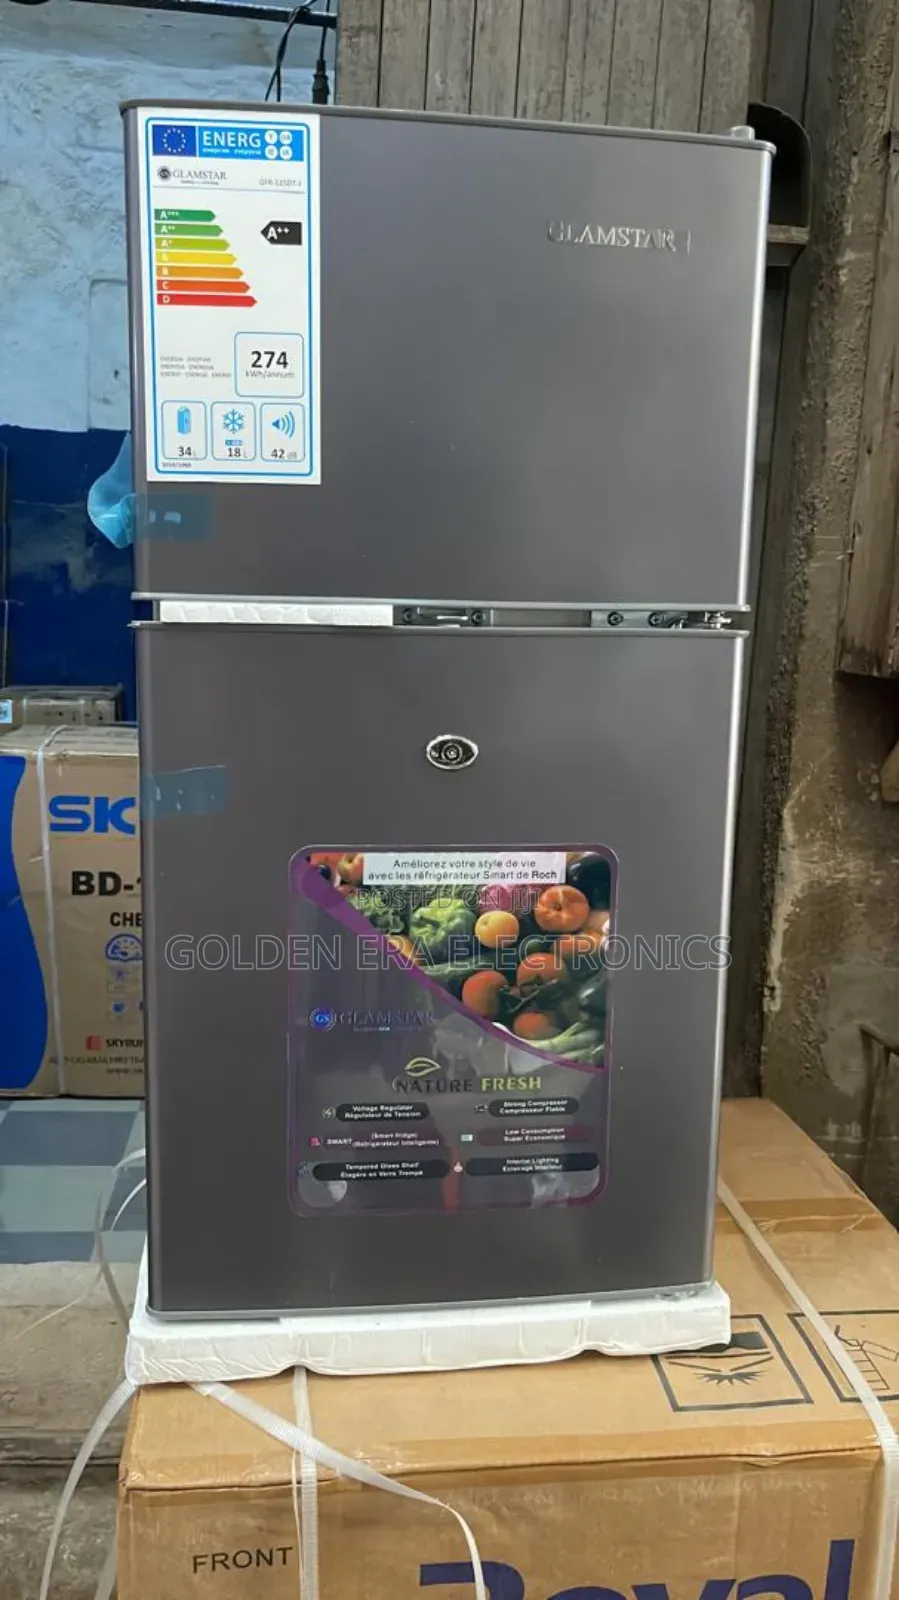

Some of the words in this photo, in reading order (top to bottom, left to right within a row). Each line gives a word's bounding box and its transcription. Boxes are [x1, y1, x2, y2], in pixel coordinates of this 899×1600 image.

[202, 130, 262, 148] ENERG
[172, 168, 227, 181] GLAMSTAR
[160, 210, 179, 220] A+++
[161, 225, 176, 234] A++
[267, 226, 290, 240] A++
[547, 220, 677, 253] GLAMSTAR
[162, 281, 169, 290] C
[162, 295, 170, 303] D
[251, 350, 289, 369] 274
[177, 446, 192, 457] 34
[227, 447, 242, 458] 18
[271, 449, 286, 460] 42
[393, 858, 447, 869] Améliorez
[448, 860, 477, 869] votre
[478, 859, 503, 870] style
[505, 859, 519, 868] de
[520, 860, 537, 868] vie
[368, 871, 394, 880] avec
[395, 871, 412, 880] les
[414, 870, 481, 882] réfrigérateur
[482, 870, 514, 880] Smart
[516, 870, 530, 880] de
[531, 870, 558, 880] Roch
[71, 870, 142, 896] BD-
[396, 1079, 473, 1094] NATURE
[481, 1076, 542, 1091] FRESH
[352, 1105, 379, 1113] Voltage
[380, 1104, 413, 1112] Regulator
[499, 1107, 545, 1115] Compresseur
[327, 1137, 352, 1145] SMART
[345, 1163, 379, 1171] Tempered
[192, 1546, 294, 1574] FRONT
